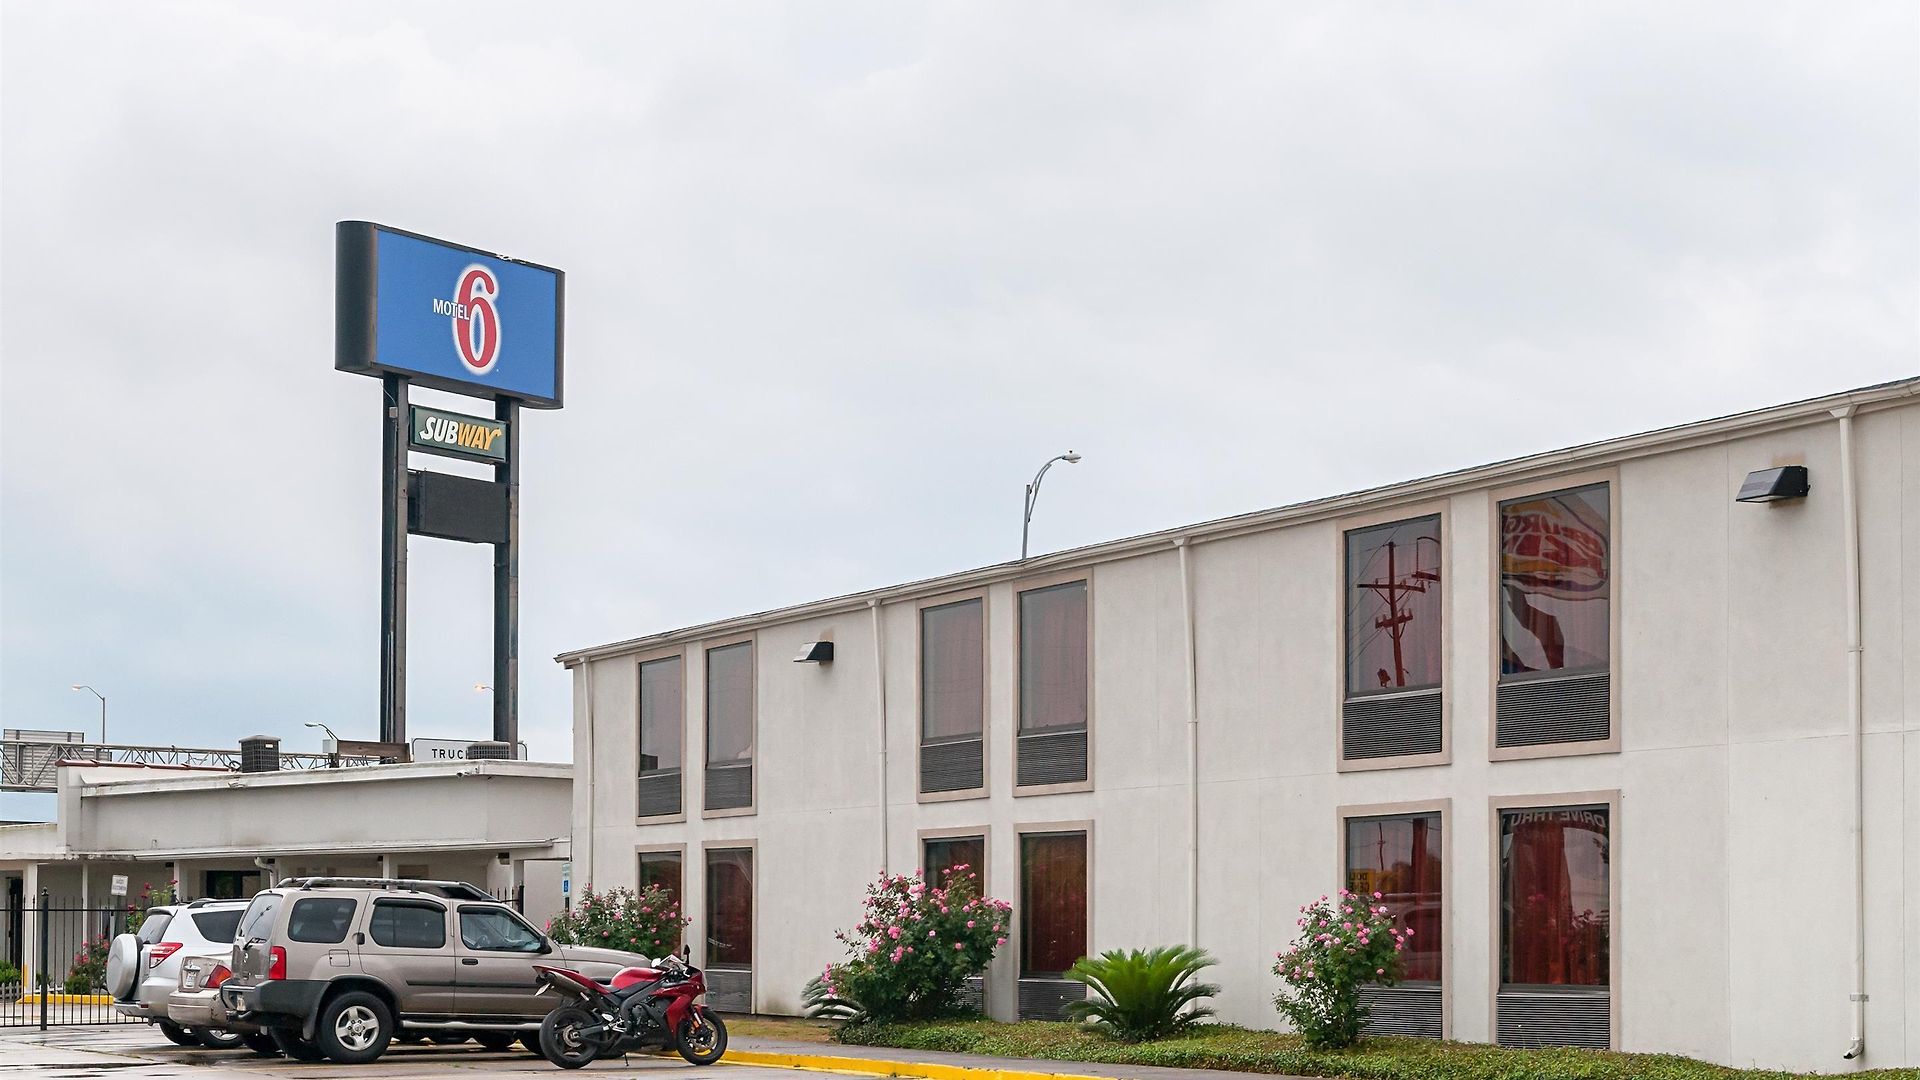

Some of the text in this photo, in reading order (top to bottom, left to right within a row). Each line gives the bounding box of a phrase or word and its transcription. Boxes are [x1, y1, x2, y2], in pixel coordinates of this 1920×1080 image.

[433, 266, 499, 371] MOTEL 6
[419, 416, 502, 450] SUBWAY
[431, 748, 468, 760] TRUC
